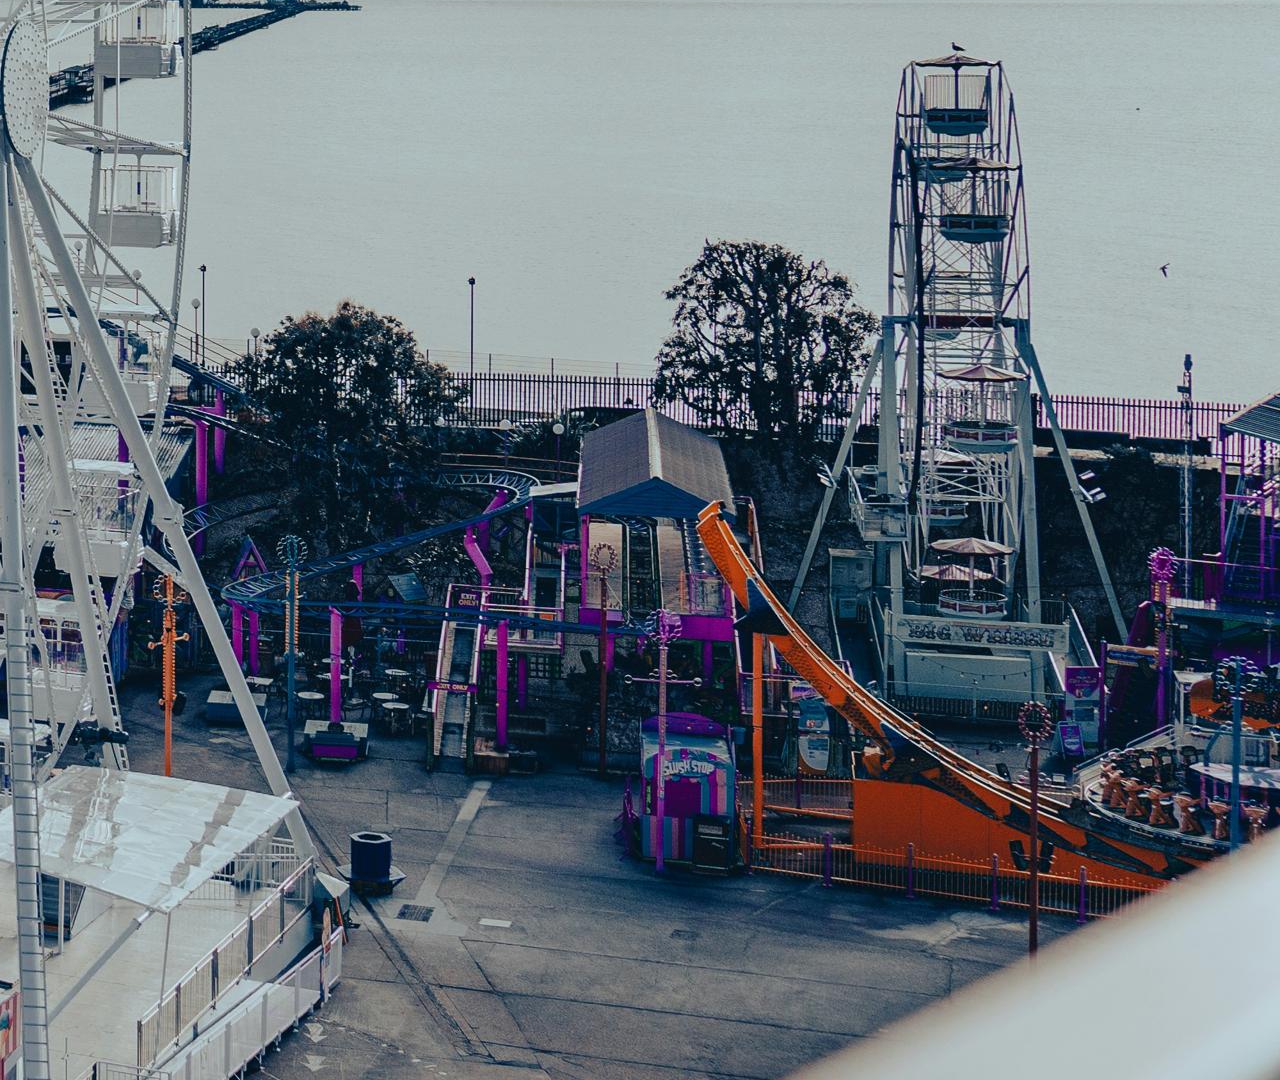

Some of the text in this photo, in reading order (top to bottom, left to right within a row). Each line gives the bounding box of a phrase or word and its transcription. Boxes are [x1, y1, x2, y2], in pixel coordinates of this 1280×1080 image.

[908, 623, 1055, 648] BIG WHEEL
[663, 760, 715, 776] SLUSH STOP
